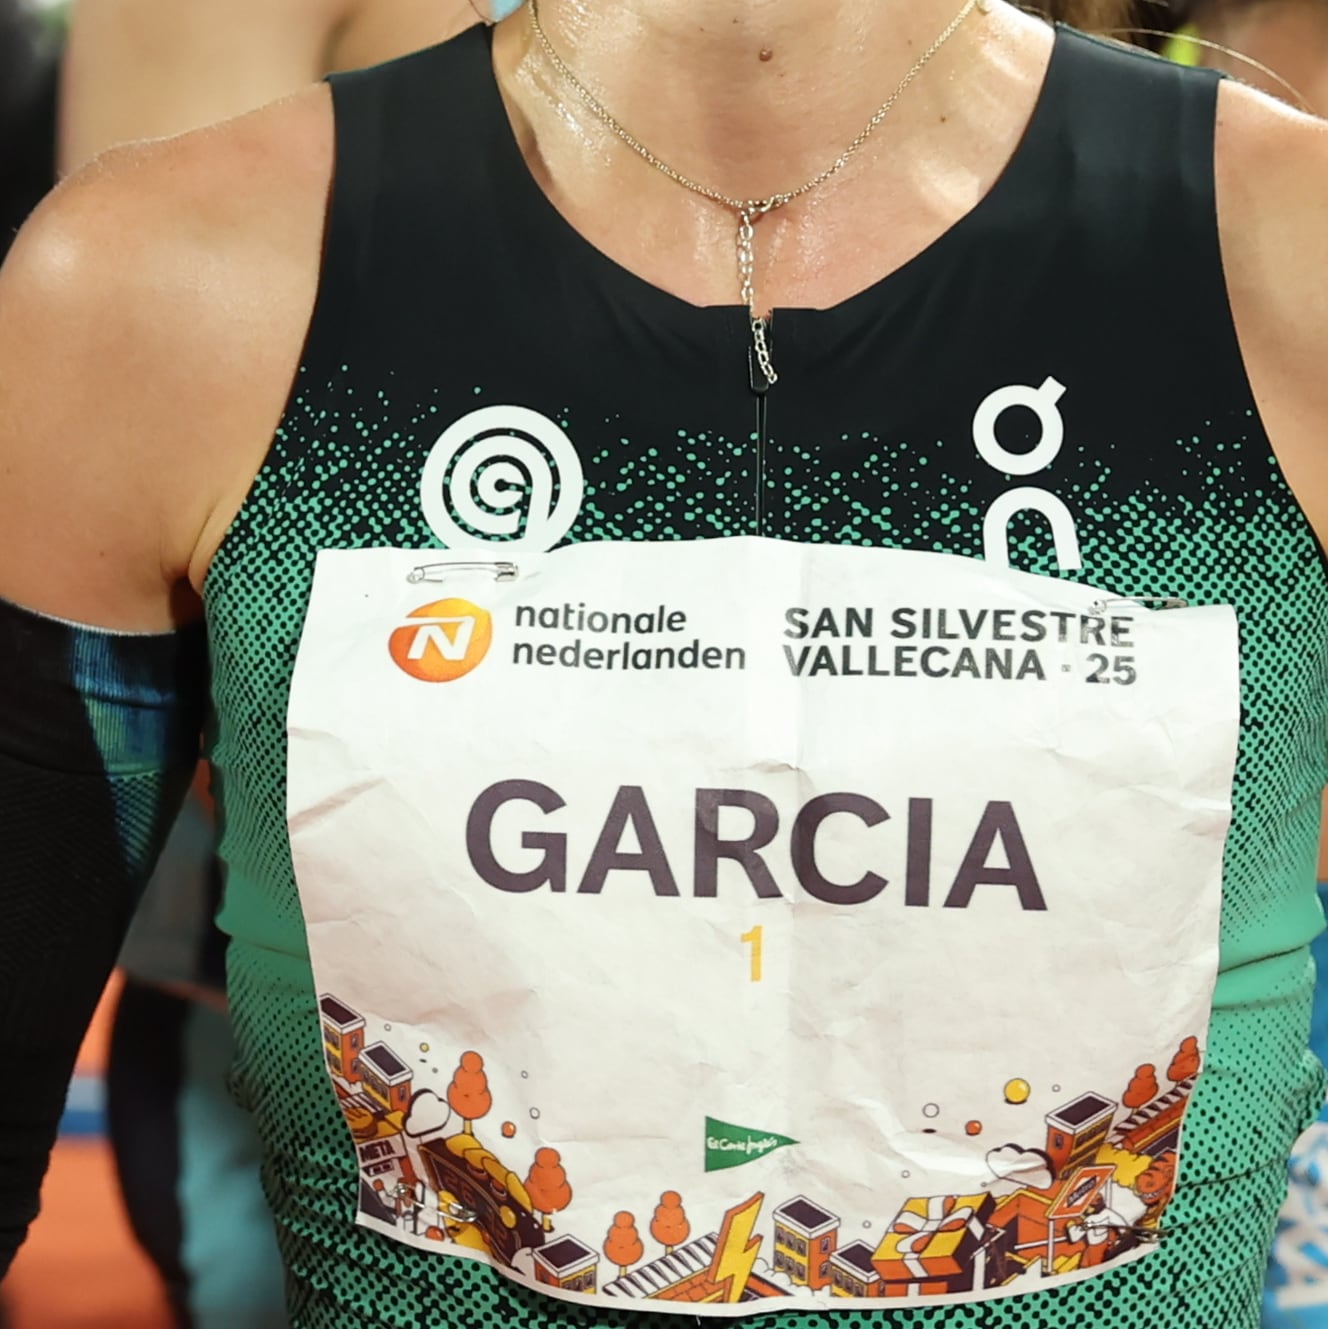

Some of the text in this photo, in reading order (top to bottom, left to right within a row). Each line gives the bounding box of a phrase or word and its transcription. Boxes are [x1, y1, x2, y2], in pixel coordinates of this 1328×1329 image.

[515, 603, 687, 634] nationale
[783, 607, 1135, 648] SAN SILVESTRE
[512, 639, 746, 670] nederlanden
[782, 644, 1046, 681] VALLECANA
[1085, 653, 1137, 686] 25
[465, 779, 1048, 912] GARCIA
[740, 926, 762, 982] 1
